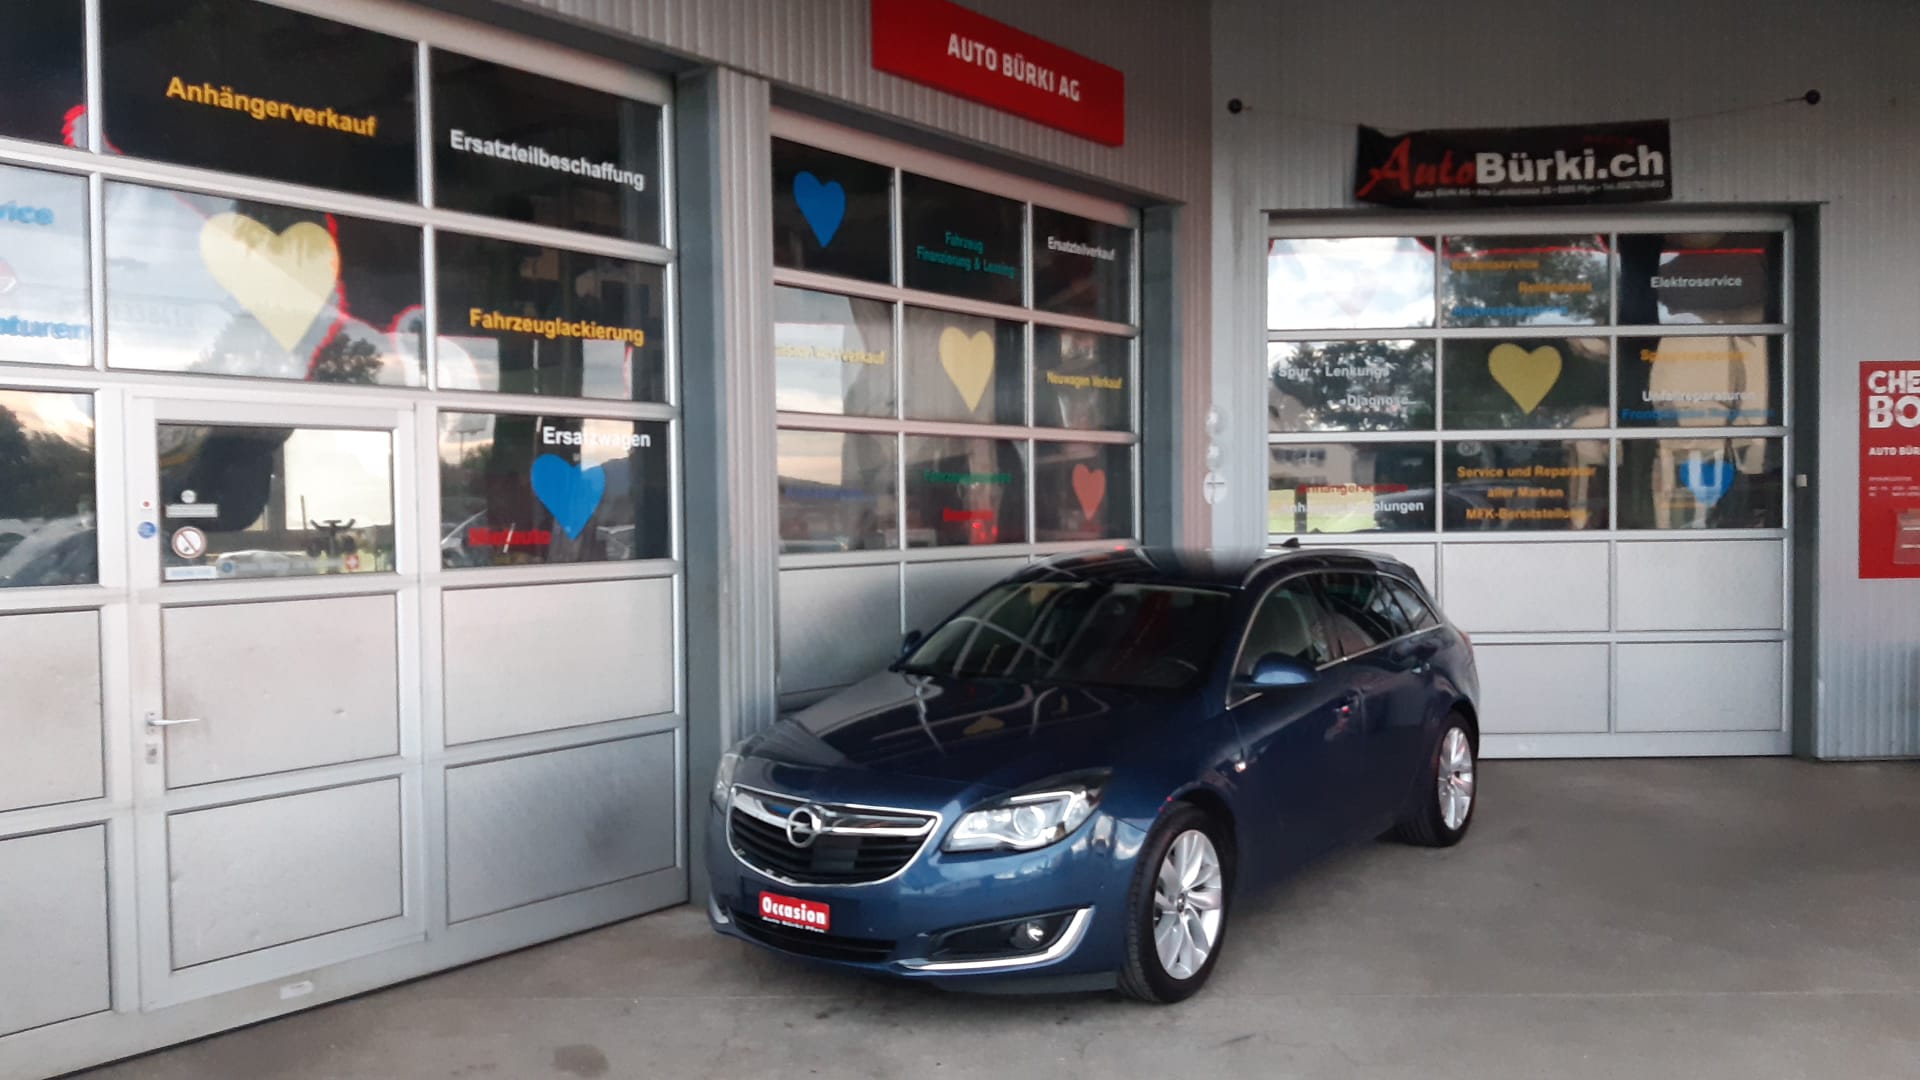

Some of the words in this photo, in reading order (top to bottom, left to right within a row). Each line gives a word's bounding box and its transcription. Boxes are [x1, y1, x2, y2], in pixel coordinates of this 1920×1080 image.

[947, 33, 997, 71] AUTO
[1002, 54, 1055, 92] BÜRKI
[1059, 79, 1081, 102] AG
[166, 76, 378, 137] Anhängerverkauf
[449, 129, 645, 191] Ersatzteilbeschaffung
[945, 232, 984, 254] Fahrzeug
[1048, 235, 1115, 261] Ersatzteilverkauf
[917, 246, 971, 271] Finanzierung
[1651, 275, 1742, 288] Elektroservice
[469, 308, 645, 346] Fahrzeuglackierung
[1278, 366, 1310, 379] Spur
[1867, 370, 1920, 394] CHE
[543, 426, 651, 450] Ersatzwagen
[1868, 447, 1897, 456] AUTO
[1457, 466, 1504, 478] Service
[1507, 466, 1532, 478] und
[1517, 486, 1565, 498] Marken
[762, 896, 826, 925] Occasion
